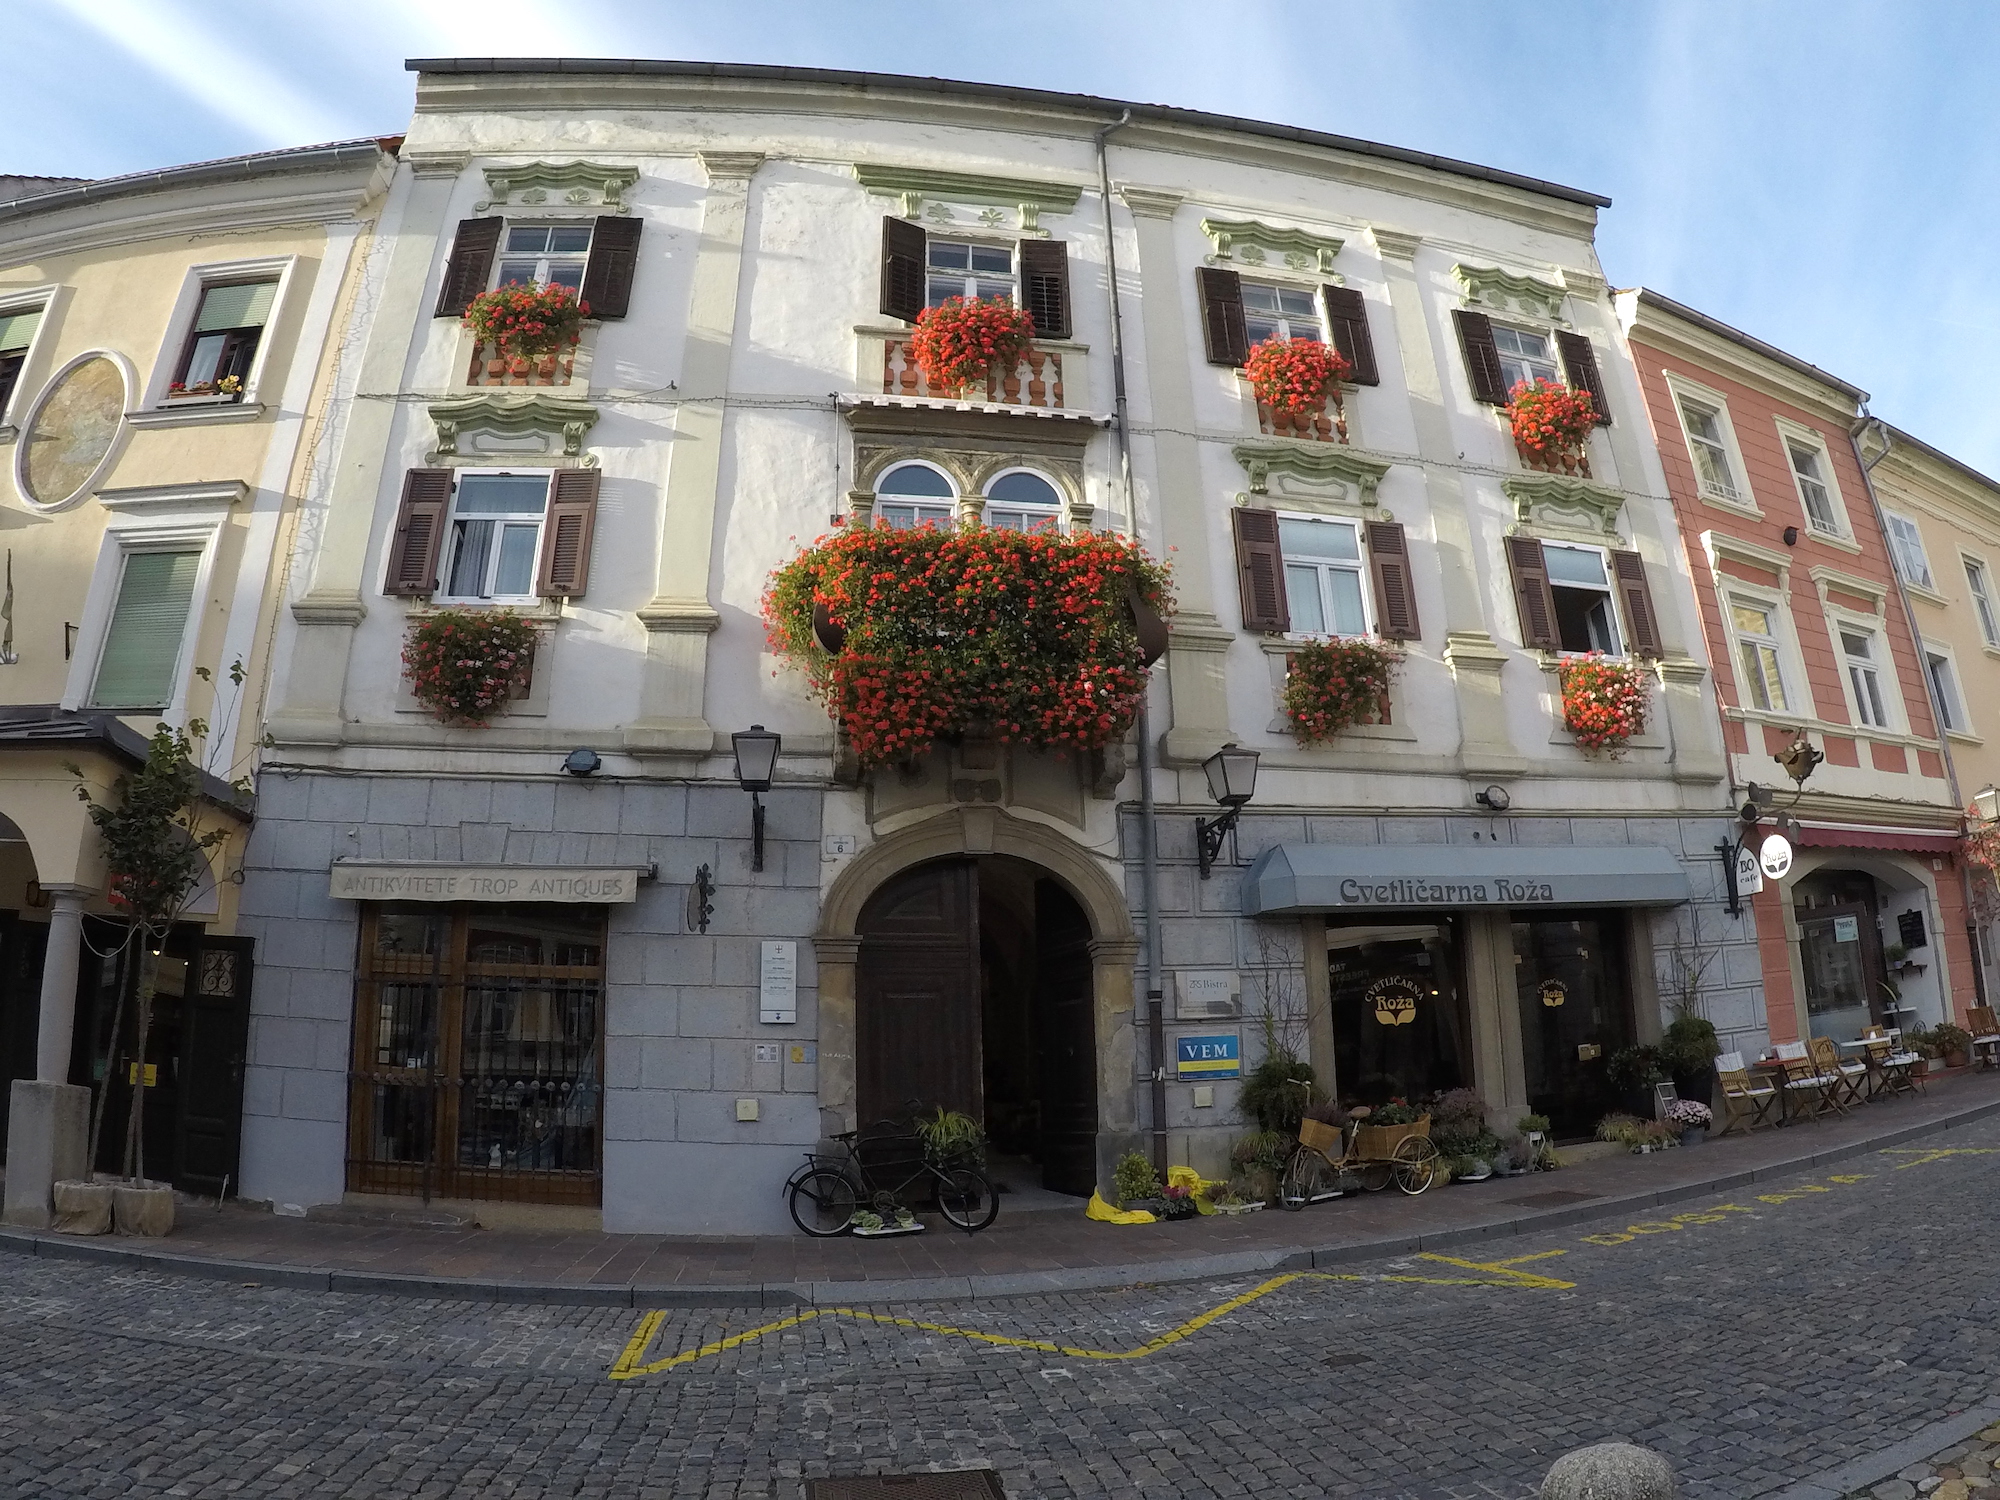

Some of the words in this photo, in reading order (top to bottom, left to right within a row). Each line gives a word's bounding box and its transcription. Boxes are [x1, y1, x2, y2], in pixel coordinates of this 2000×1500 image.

[837, 844, 844, 853] 6
[1740, 858, 1755, 874] BO
[343, 876, 457, 894] ANTIKVITETE
[469, 877, 519, 895] TROP
[529, 878, 623, 899] ANTIQUES
[1339, 878, 1488, 903] Cvetličarna
[1494, 878, 1555, 901] Roža
[1203, 979, 1228, 989] Bistra
[1364, 975, 1425, 1002] CVETLIČARNA
[1375, 995, 1415, 1011] Roža
[1186, 1043, 1229, 1059] VEM
